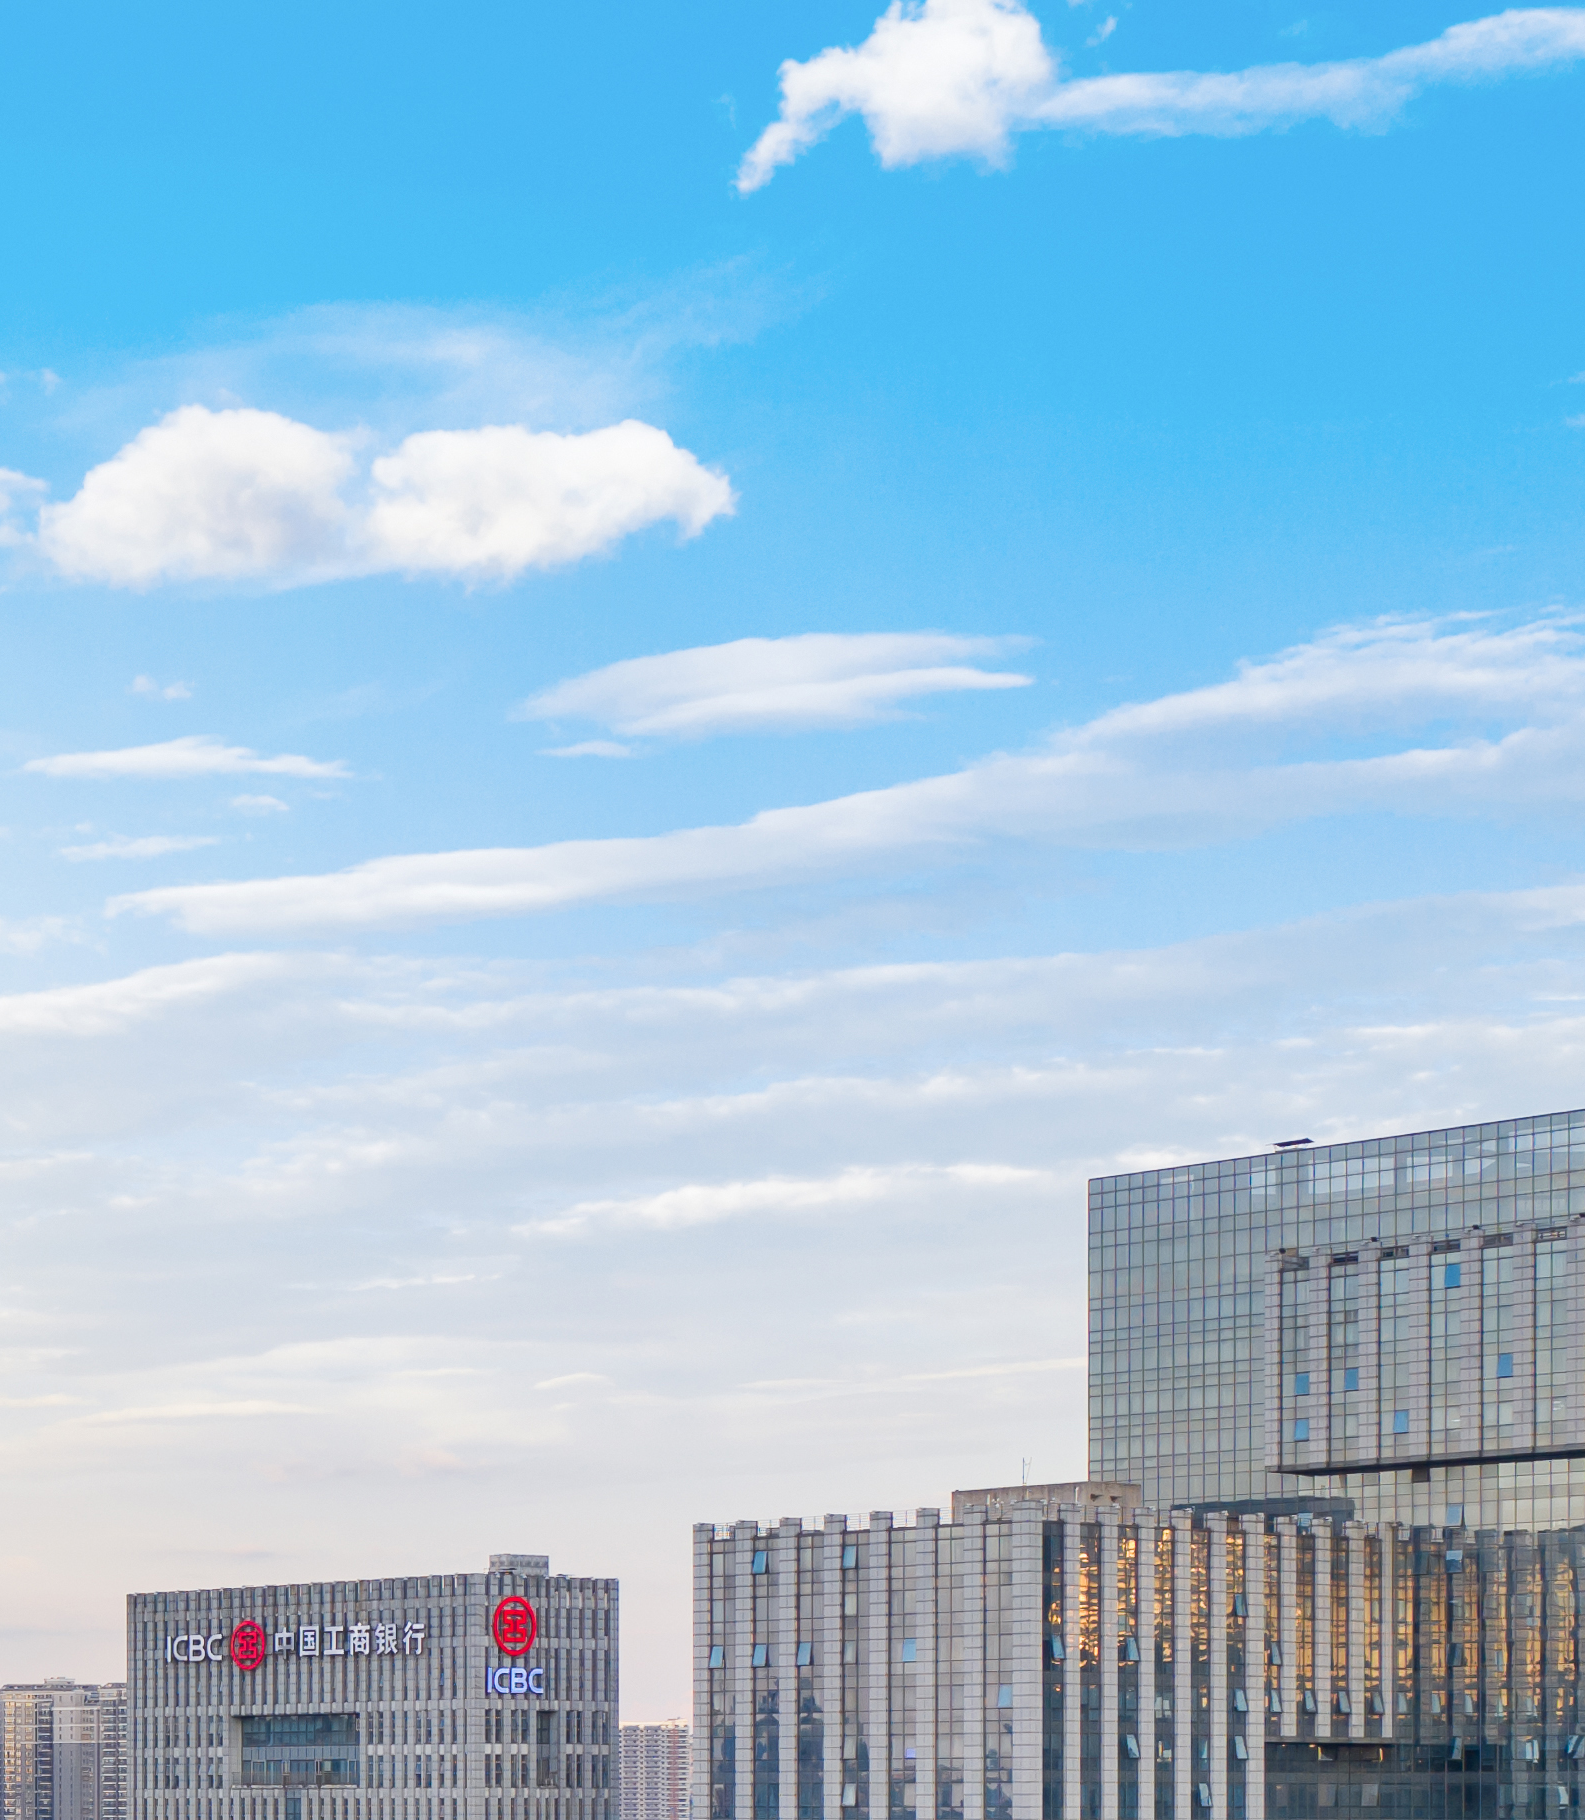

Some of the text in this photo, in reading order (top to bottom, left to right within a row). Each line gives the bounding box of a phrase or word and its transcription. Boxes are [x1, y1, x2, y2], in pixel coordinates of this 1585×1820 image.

[166, 1621, 426, 1662] ICBC 中国工商银行
[487, 1666, 544, 1694] ICBC
